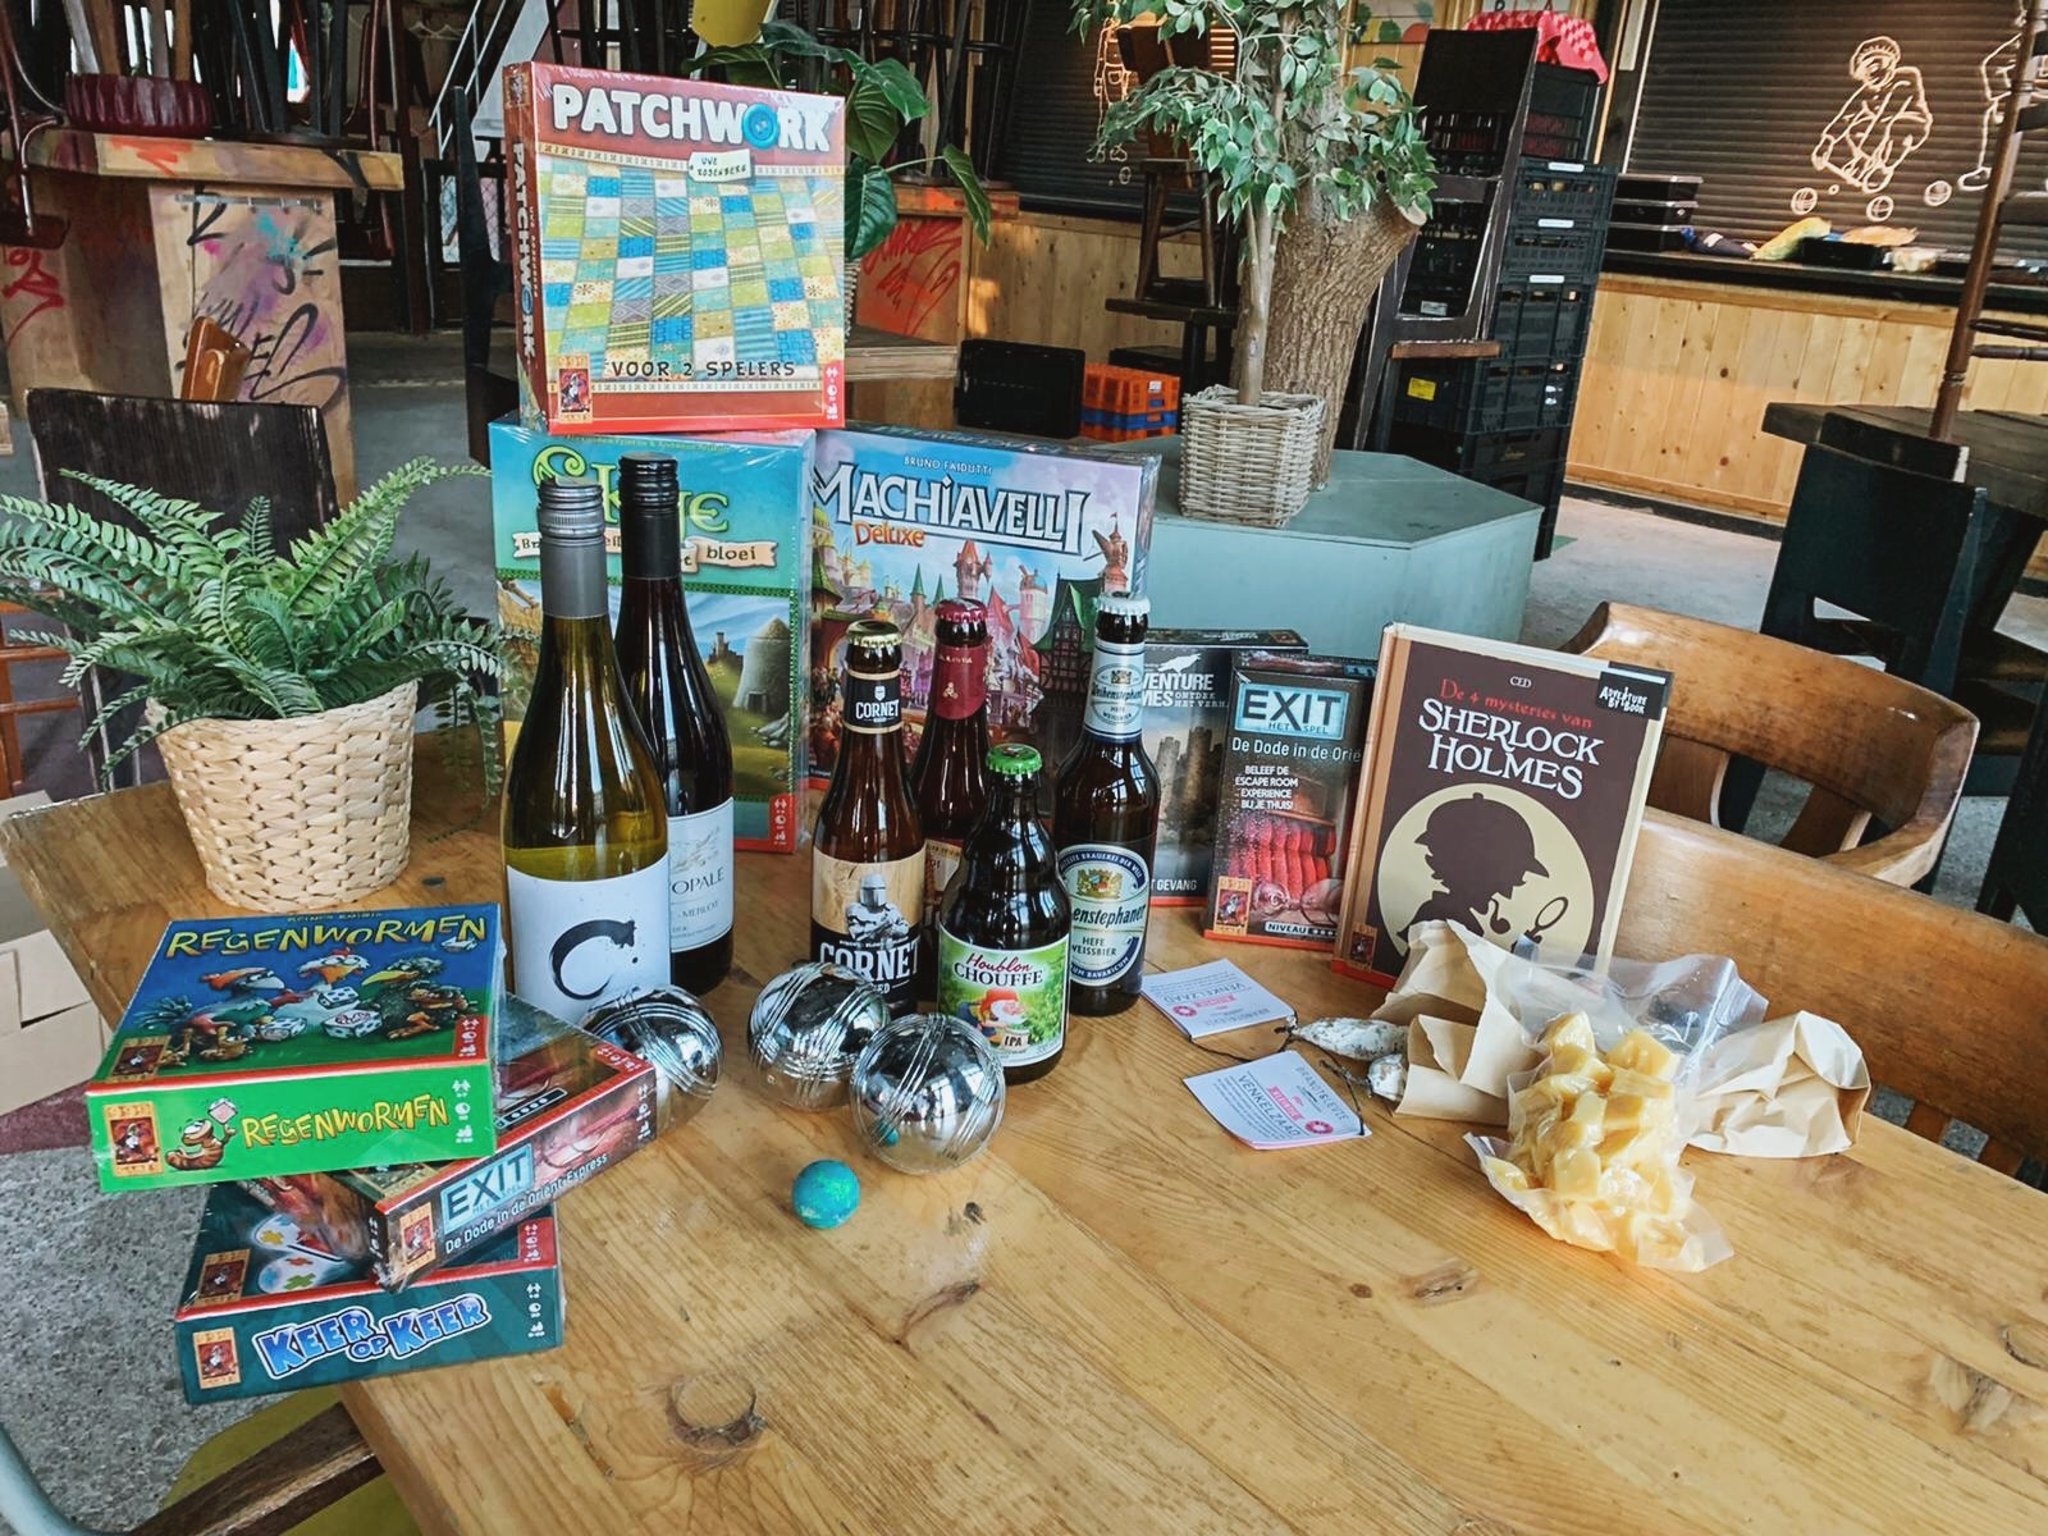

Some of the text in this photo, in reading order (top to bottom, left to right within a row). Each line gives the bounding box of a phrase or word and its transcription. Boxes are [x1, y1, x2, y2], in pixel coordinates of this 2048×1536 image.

[551, 83, 830, 152] PATCHWORK
[513, 142, 535, 358] PATCHWORK
[612, 361, 795, 377] VOOR 2 SPELERS
[904, 455, 992, 475] BRUNO FAIDUTTI
[810, 461, 1093, 555] MACHIAVELLI
[853, 520, 926, 547] Deluxe
[706, 545, 757, 562] bloei
[1142, 673, 1214, 691] VENTURE
[1440, 679, 1593, 728] De 4 mysteries van
[1599, 686, 1648, 706] ADVENTURE
[1608, 697, 1645, 715] BY BOOK
[855, 699, 899, 719] CORNET
[1242, 689, 1341, 730] EXIT
[1268, 722, 1329, 734] HET SPEL
[1418, 697, 1604, 766] SHERLOCK
[1232, 737, 1249, 752] De
[1254, 740, 1289, 756] Dode
[1293, 743, 1307, 757] in
[1310, 745, 1329, 760] de
[1245, 765, 1289, 775] BELEEF DE
[1428, 734, 1584, 800] HOLMES
[1235, 777, 1298, 787] ESCAPE ROOM
[1241, 789, 1292, 798] EXPERIENCE
[1254, 800, 1264, 809] JE
[671, 866, 725, 895] OPALE
[1157, 879, 1197, 891] GEVANG
[1073, 904, 1147, 928] enstephaner
[166, 914, 486, 958] REGENWORMEN
[1267, 923, 1306, 934] NIVEAU
[1082, 937, 1104, 946] HEFE
[954, 961, 1043, 987] CHOUFFE
[966, 952, 1032, 973] Houblon
[1238, 1075, 1301, 1137] VENKELZAAD
[241, 1094, 449, 1149] REGENWORMEN
[447, 1149, 528, 1220] EXIT
[445, 1235, 462, 1253] De
[464, 1217, 495, 1243] Dode
[497, 1210, 509, 1225] in
[511, 1202, 526, 1216] de
[260, 1309, 373, 1375] KEER
[351, 1335, 388, 1358] OP
[386, 1297, 487, 1355] KEER
